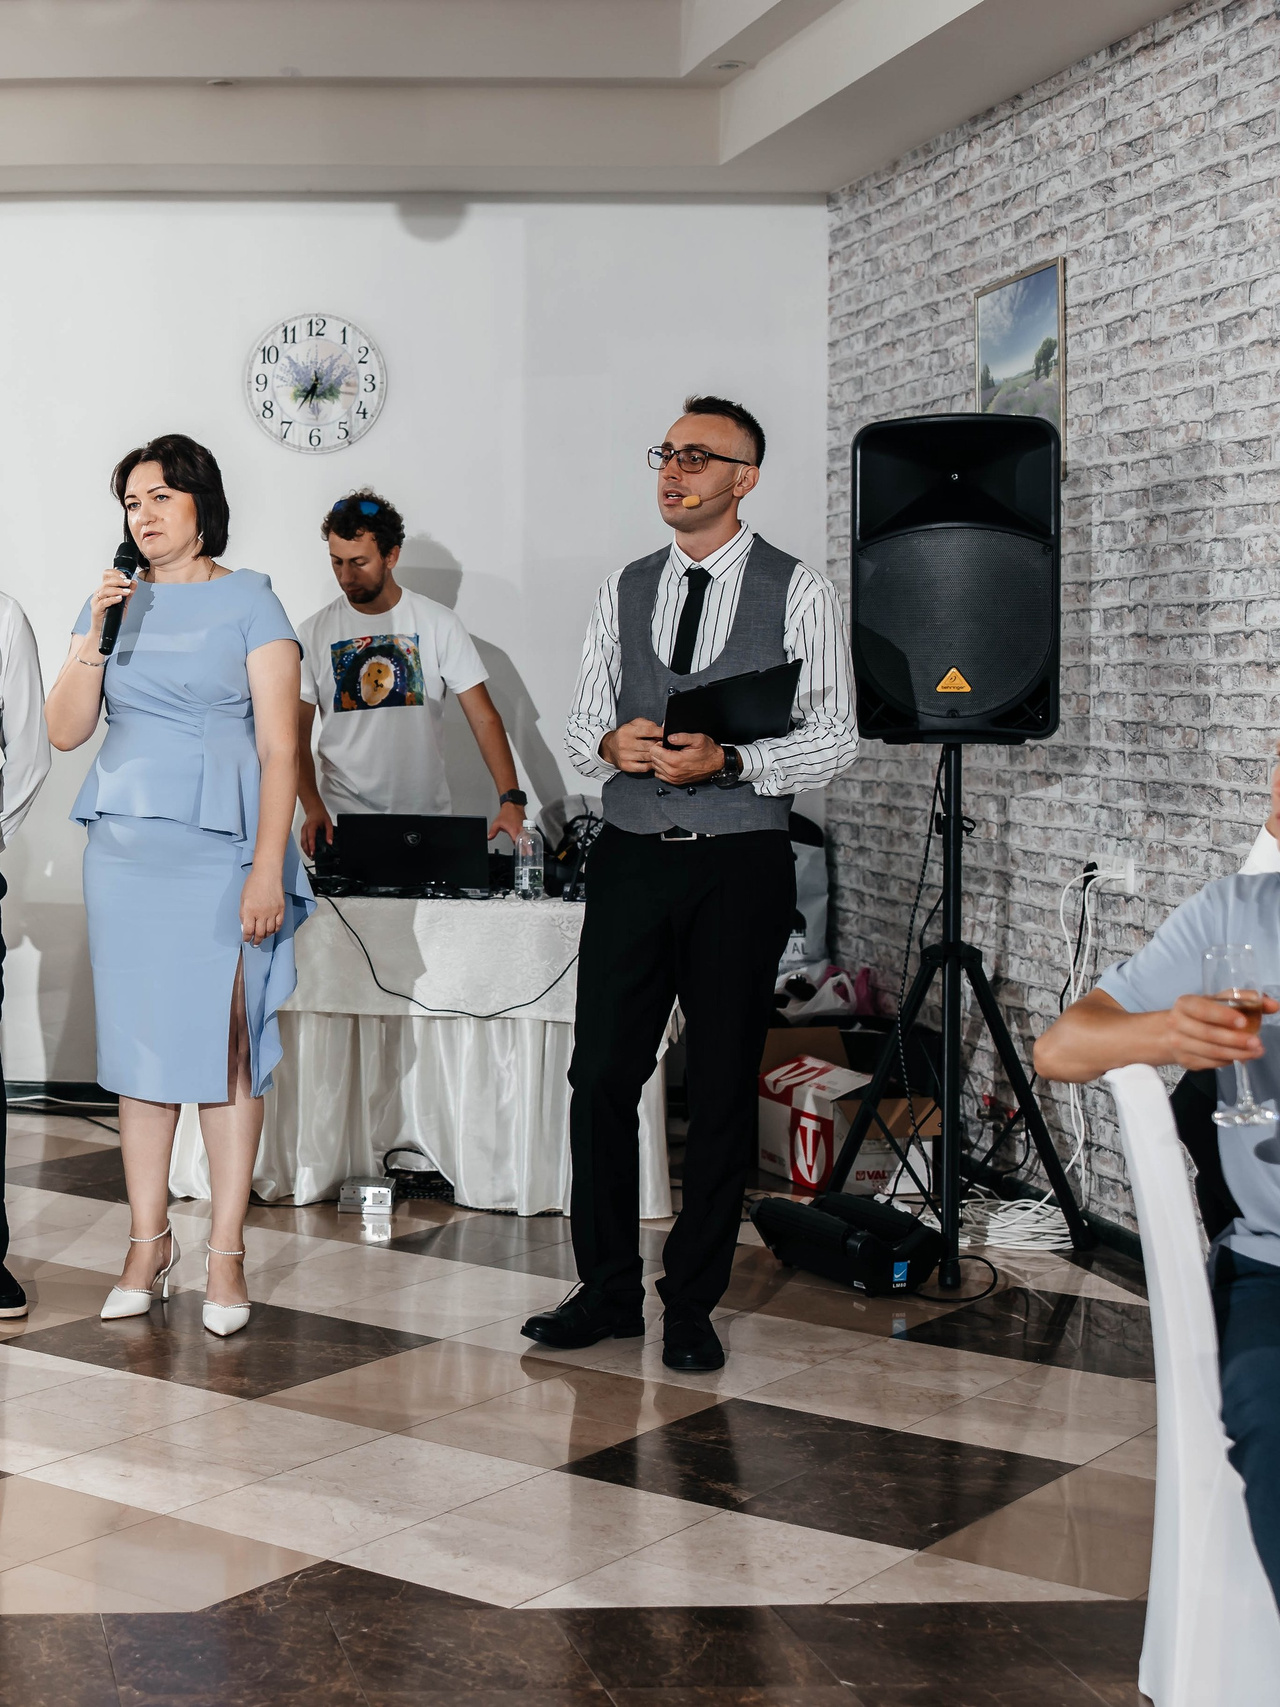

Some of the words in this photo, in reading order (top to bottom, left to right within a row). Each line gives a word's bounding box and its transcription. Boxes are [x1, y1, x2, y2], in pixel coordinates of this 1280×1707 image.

[281, 325, 297, 344] 11
[307, 318, 327, 337] 12
[340, 326, 348, 345] 1
[261, 345, 279, 364] 10
[357, 346, 369, 364] 2
[255, 373, 268, 392] 9
[363, 374, 376, 393] 3
[261, 400, 274, 419] 8
[355, 400, 368, 420] 4
[280, 421, 293, 439] 7
[308, 428, 322, 447] 6
[337, 421, 349, 440] 5
